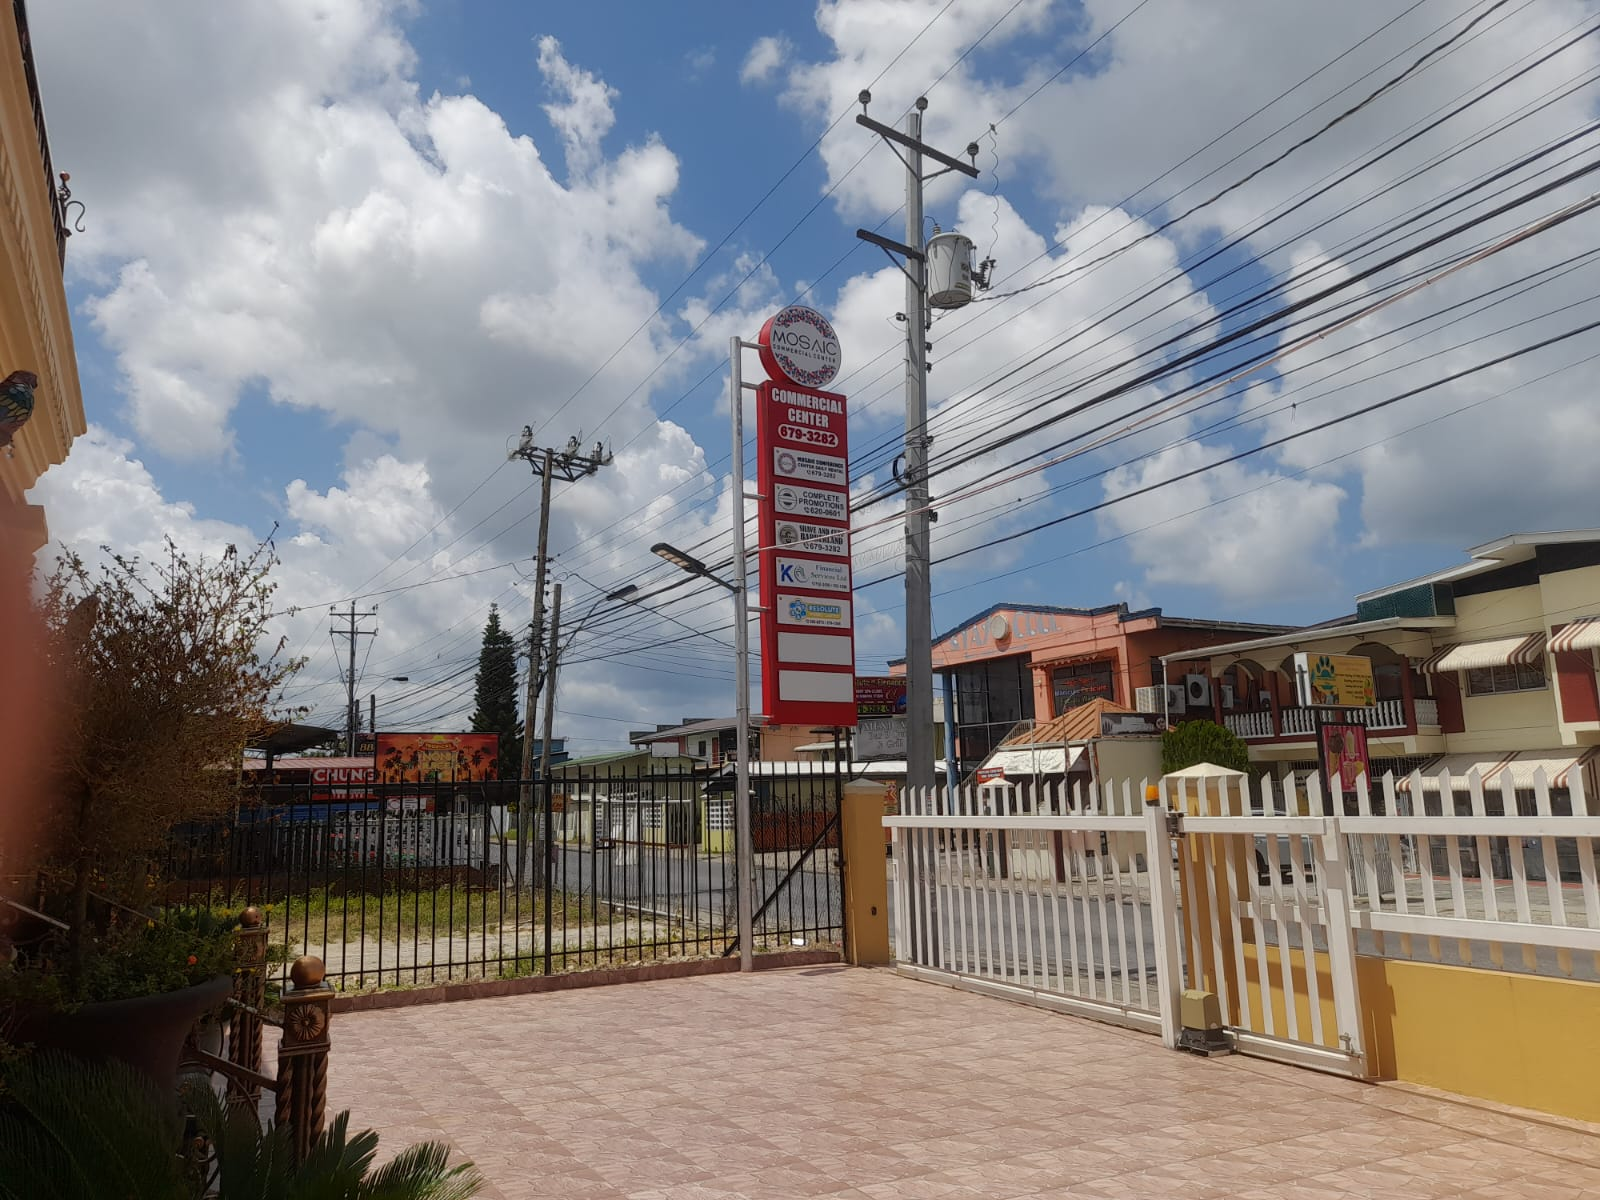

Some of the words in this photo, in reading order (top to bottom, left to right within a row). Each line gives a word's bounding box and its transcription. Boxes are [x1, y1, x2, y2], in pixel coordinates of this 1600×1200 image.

[772, 329, 837, 356] MOSAIC
[771, 387, 843, 415] COMMERCIAL
[787, 407, 829, 429] CENTER
[780, 426, 836, 446] 679-3282
[798, 497, 845, 511] PROMOTIONS
[803, 491, 840, 502] COMPLETE
[818, 527, 830, 535] AND
[313, 768, 375, 782] CHUNG
